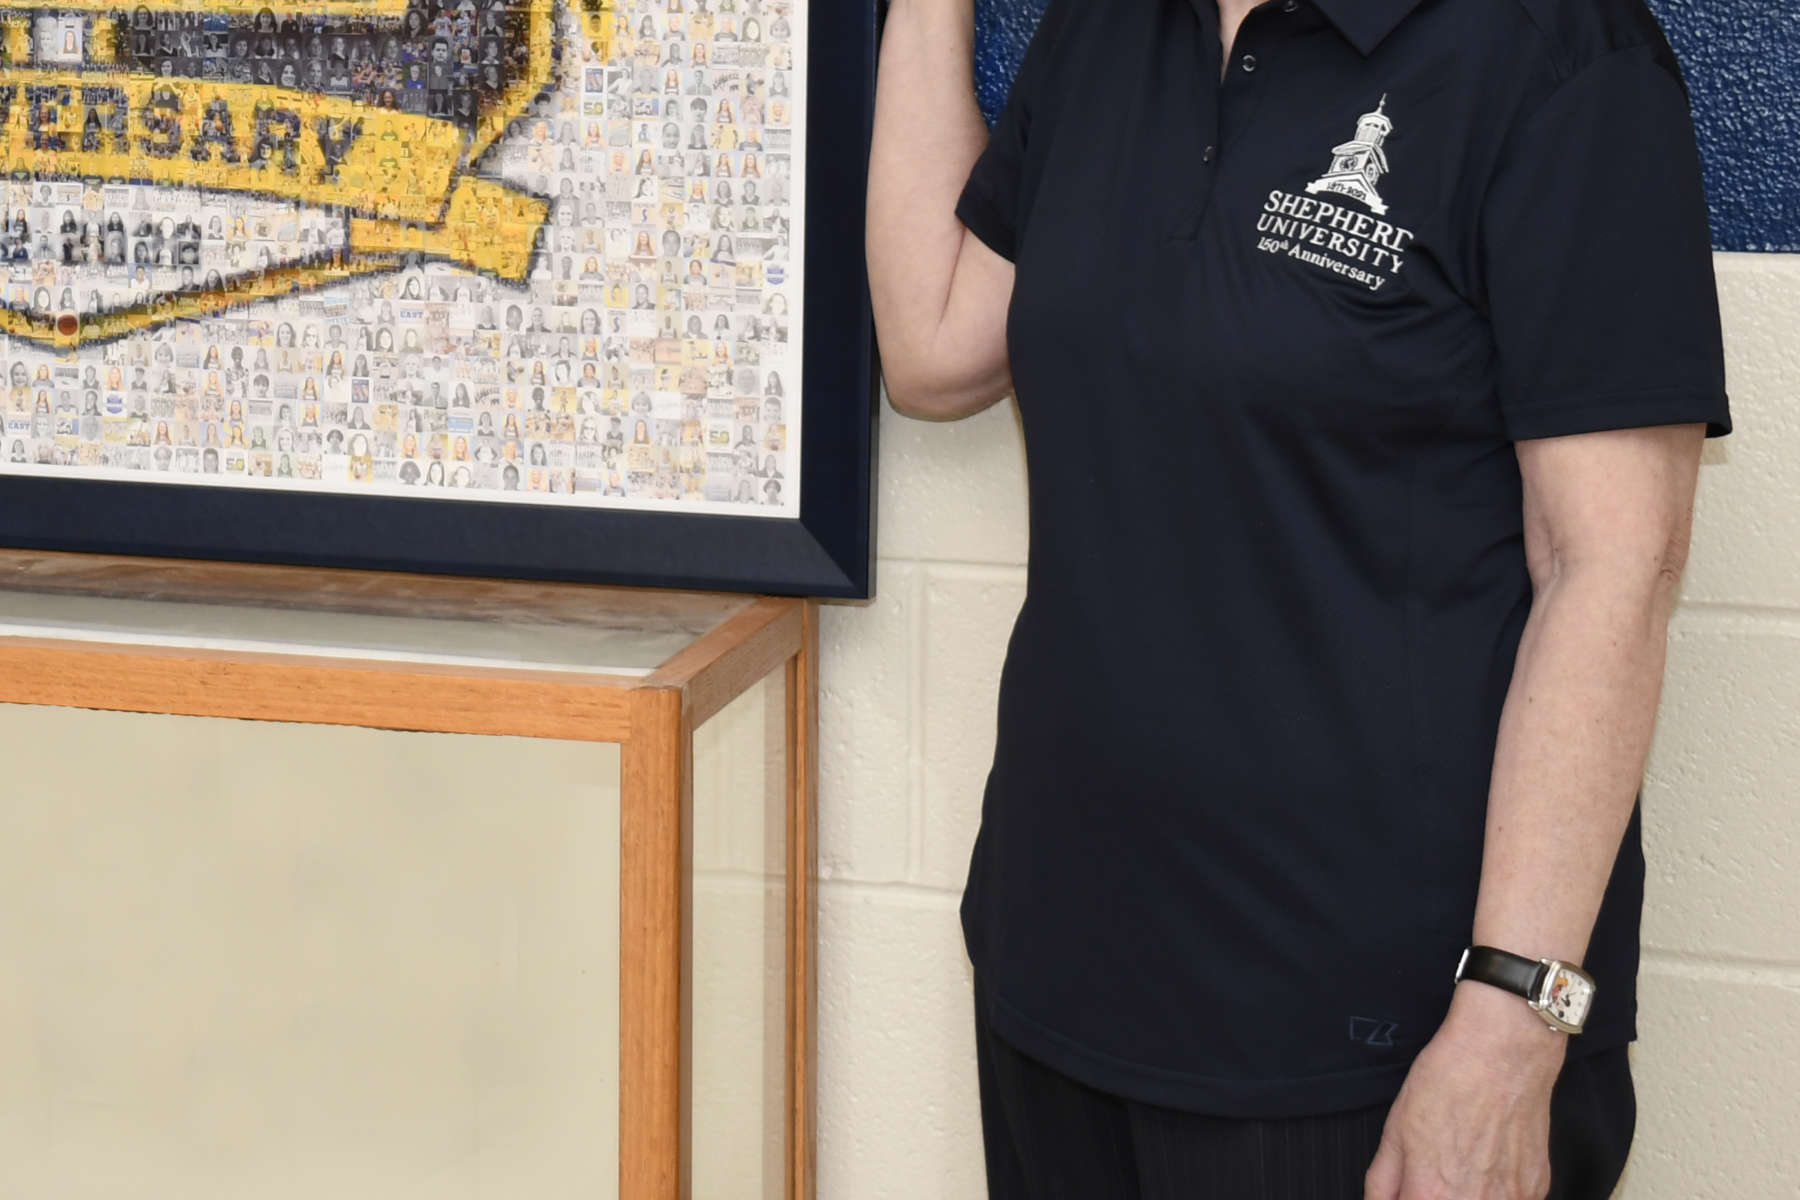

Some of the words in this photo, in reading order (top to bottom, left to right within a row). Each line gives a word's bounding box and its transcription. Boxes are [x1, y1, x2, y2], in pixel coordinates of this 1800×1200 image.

[1256, 213, 1404, 274] UNIVERSITY
[1257, 236, 1290, 253] 150th
[1288, 245, 1386, 291] Anniversary
